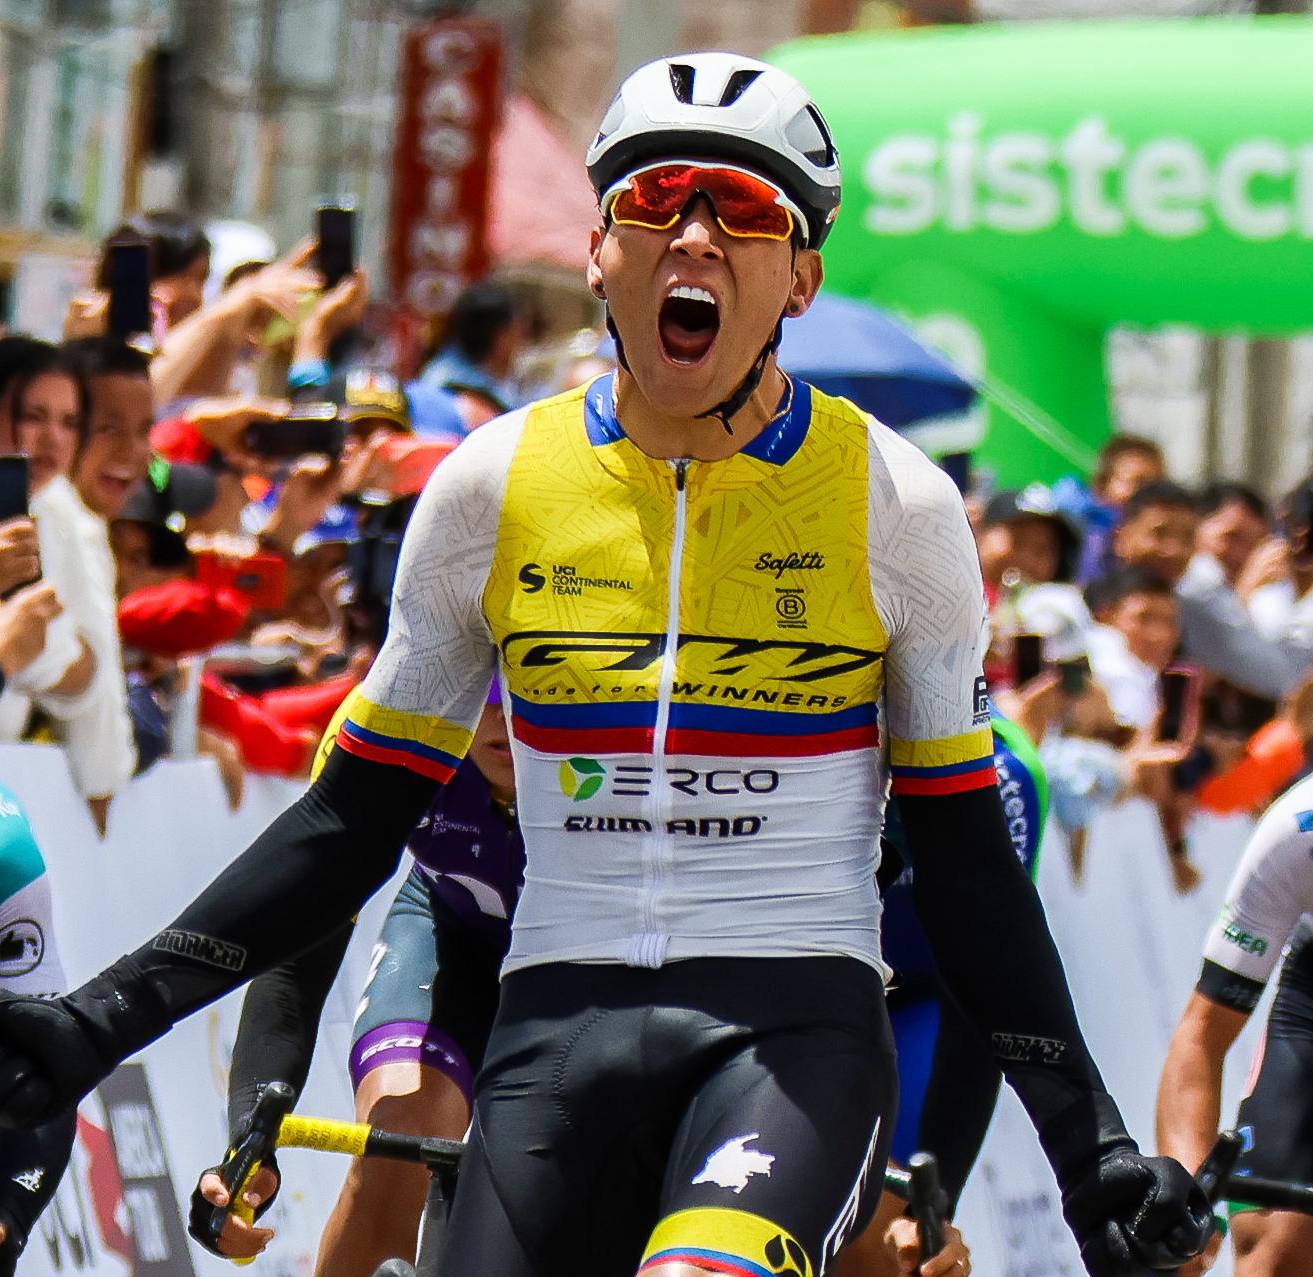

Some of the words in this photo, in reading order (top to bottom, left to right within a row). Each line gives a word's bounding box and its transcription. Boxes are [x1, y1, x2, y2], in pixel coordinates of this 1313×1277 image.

[552, 565, 576, 576] UCI
[754, 552, 825, 580] Safetti
[552, 575, 633, 591] CONTINENTAL
[552, 585, 582, 597] TEAM
[672, 681, 848, 709] WINNERS
[611, 765, 781, 797] ERCO
